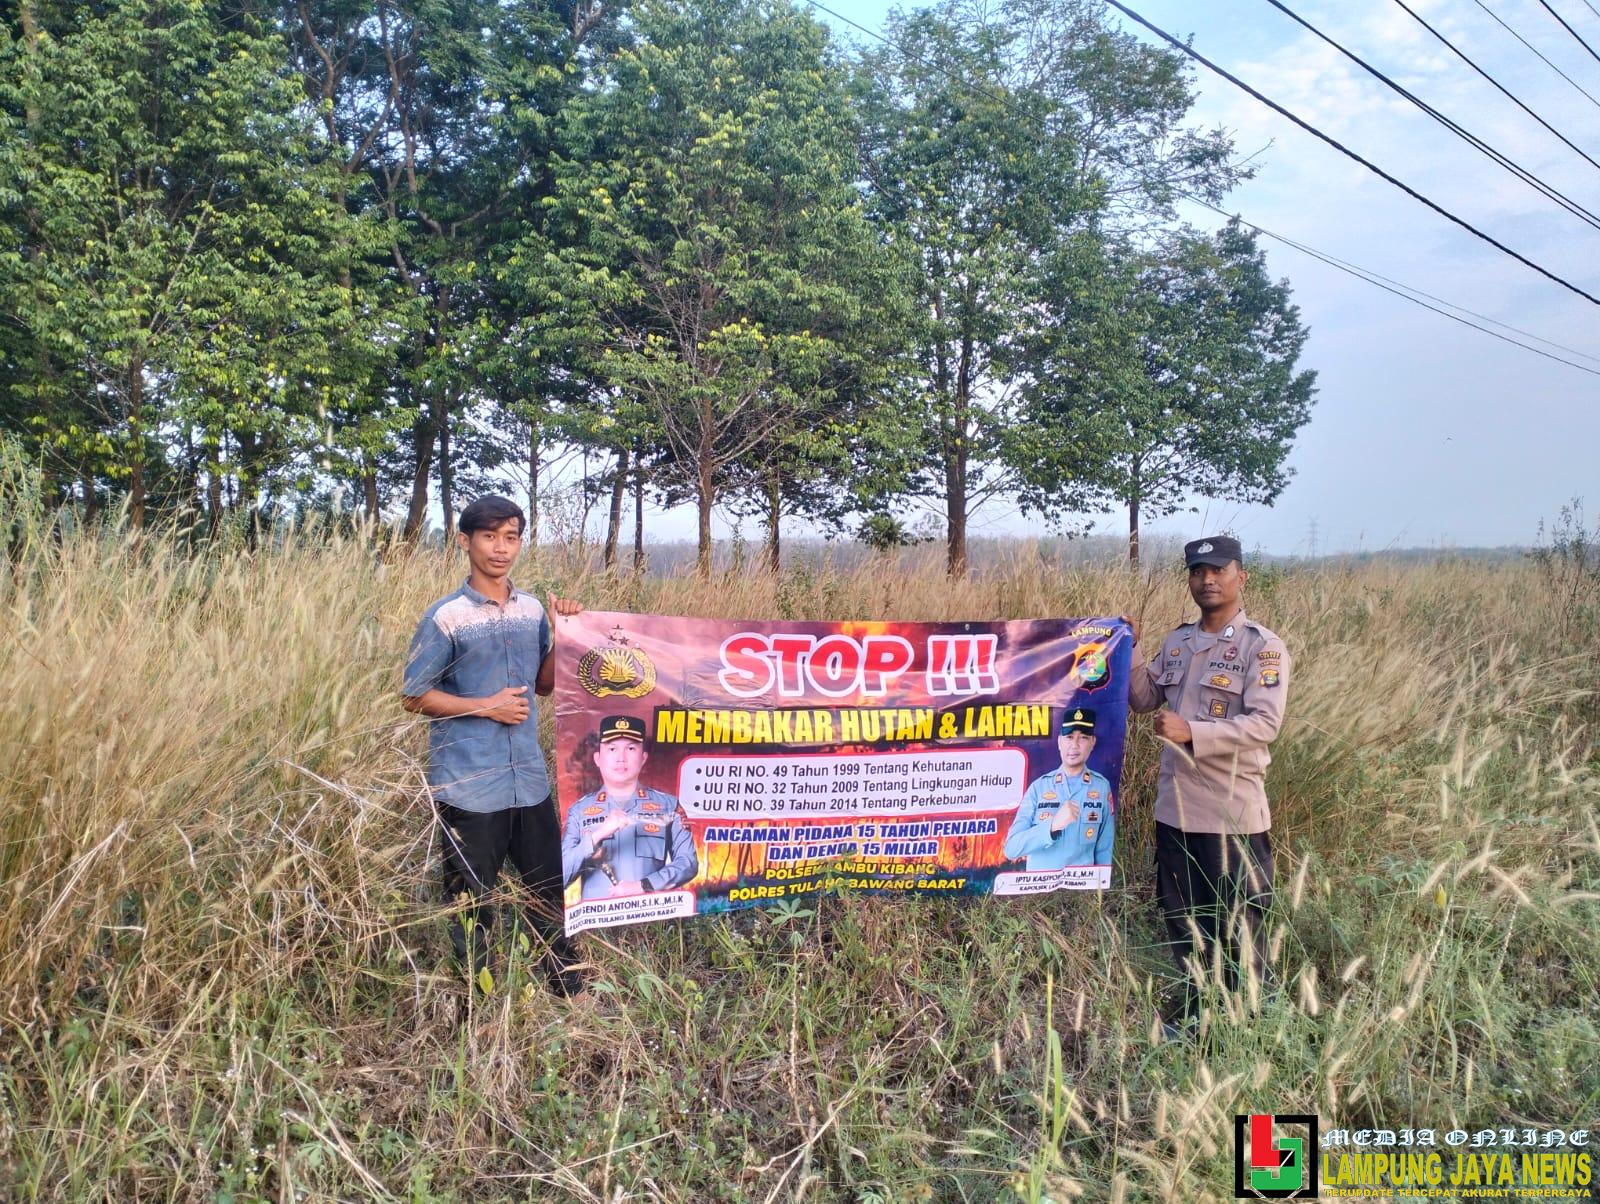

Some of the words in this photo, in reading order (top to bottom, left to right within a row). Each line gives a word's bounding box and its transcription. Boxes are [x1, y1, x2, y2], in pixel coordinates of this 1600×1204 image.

[1071, 626, 1112, 637] LAMPUNG
[718, 632, 914, 697] STOP
[926, 634, 1000, 696] !!!
[1209, 661, 1245, 673] POLRI
[656, 709, 833, 744] MEMBAKAR
[841, 708, 934, 742] HUTAN
[938, 712, 958, 740] &
[965, 705, 1049, 739] LAHAN
[705, 765, 725, 777] UU
[729, 765, 742, 777] RI
[746, 765, 769, 778] NO.
[773, 765, 788, 777] 49
[792, 764, 829, 777] Tahun
[832, 763, 860, 776] 1999
[864, 763, 909, 776] Tentang
[912, 760, 972, 773] Kehutanan
[704, 782, 723, 794] UU
[727, 782, 741, 794] RI
[744, 782, 768, 795] NO.
[772, 782, 786, 794] 32
[791, 782, 828, 794] Tahun
[831, 780, 859, 793] 2009
[863, 780, 908, 793] Tentang
[912, 776, 977, 791] Lingkungan
[981, 774, 1013, 788] Hidup
[703, 799, 722, 812] UU
[726, 799, 739, 811] RI
[743, 799, 766, 812] NO.
[770, 799, 785, 811] 39
[789, 799, 826, 811] Tahun
[830, 798, 858, 810] 2014
[862, 796, 907, 810] Tentang
[911, 794, 977, 807] Perkebunan
[705, 828, 790, 842] ANCAMAN
[794, 826, 852, 841] PIDANA
[857, 824, 876, 838] 15
[880, 823, 929, 838] TAHUN
[933, 820, 997, 835] PENJARA
[769, 846, 803, 860] DAN
[862, 842, 880, 855] 15
[884, 841, 938, 855] MILIAR
[880, 862, 936, 875] KIBANG
[729, 885, 785, 902] POLRES
[849, 879, 914, 890] BAWANG
[917, 879, 966, 890] BARAT
